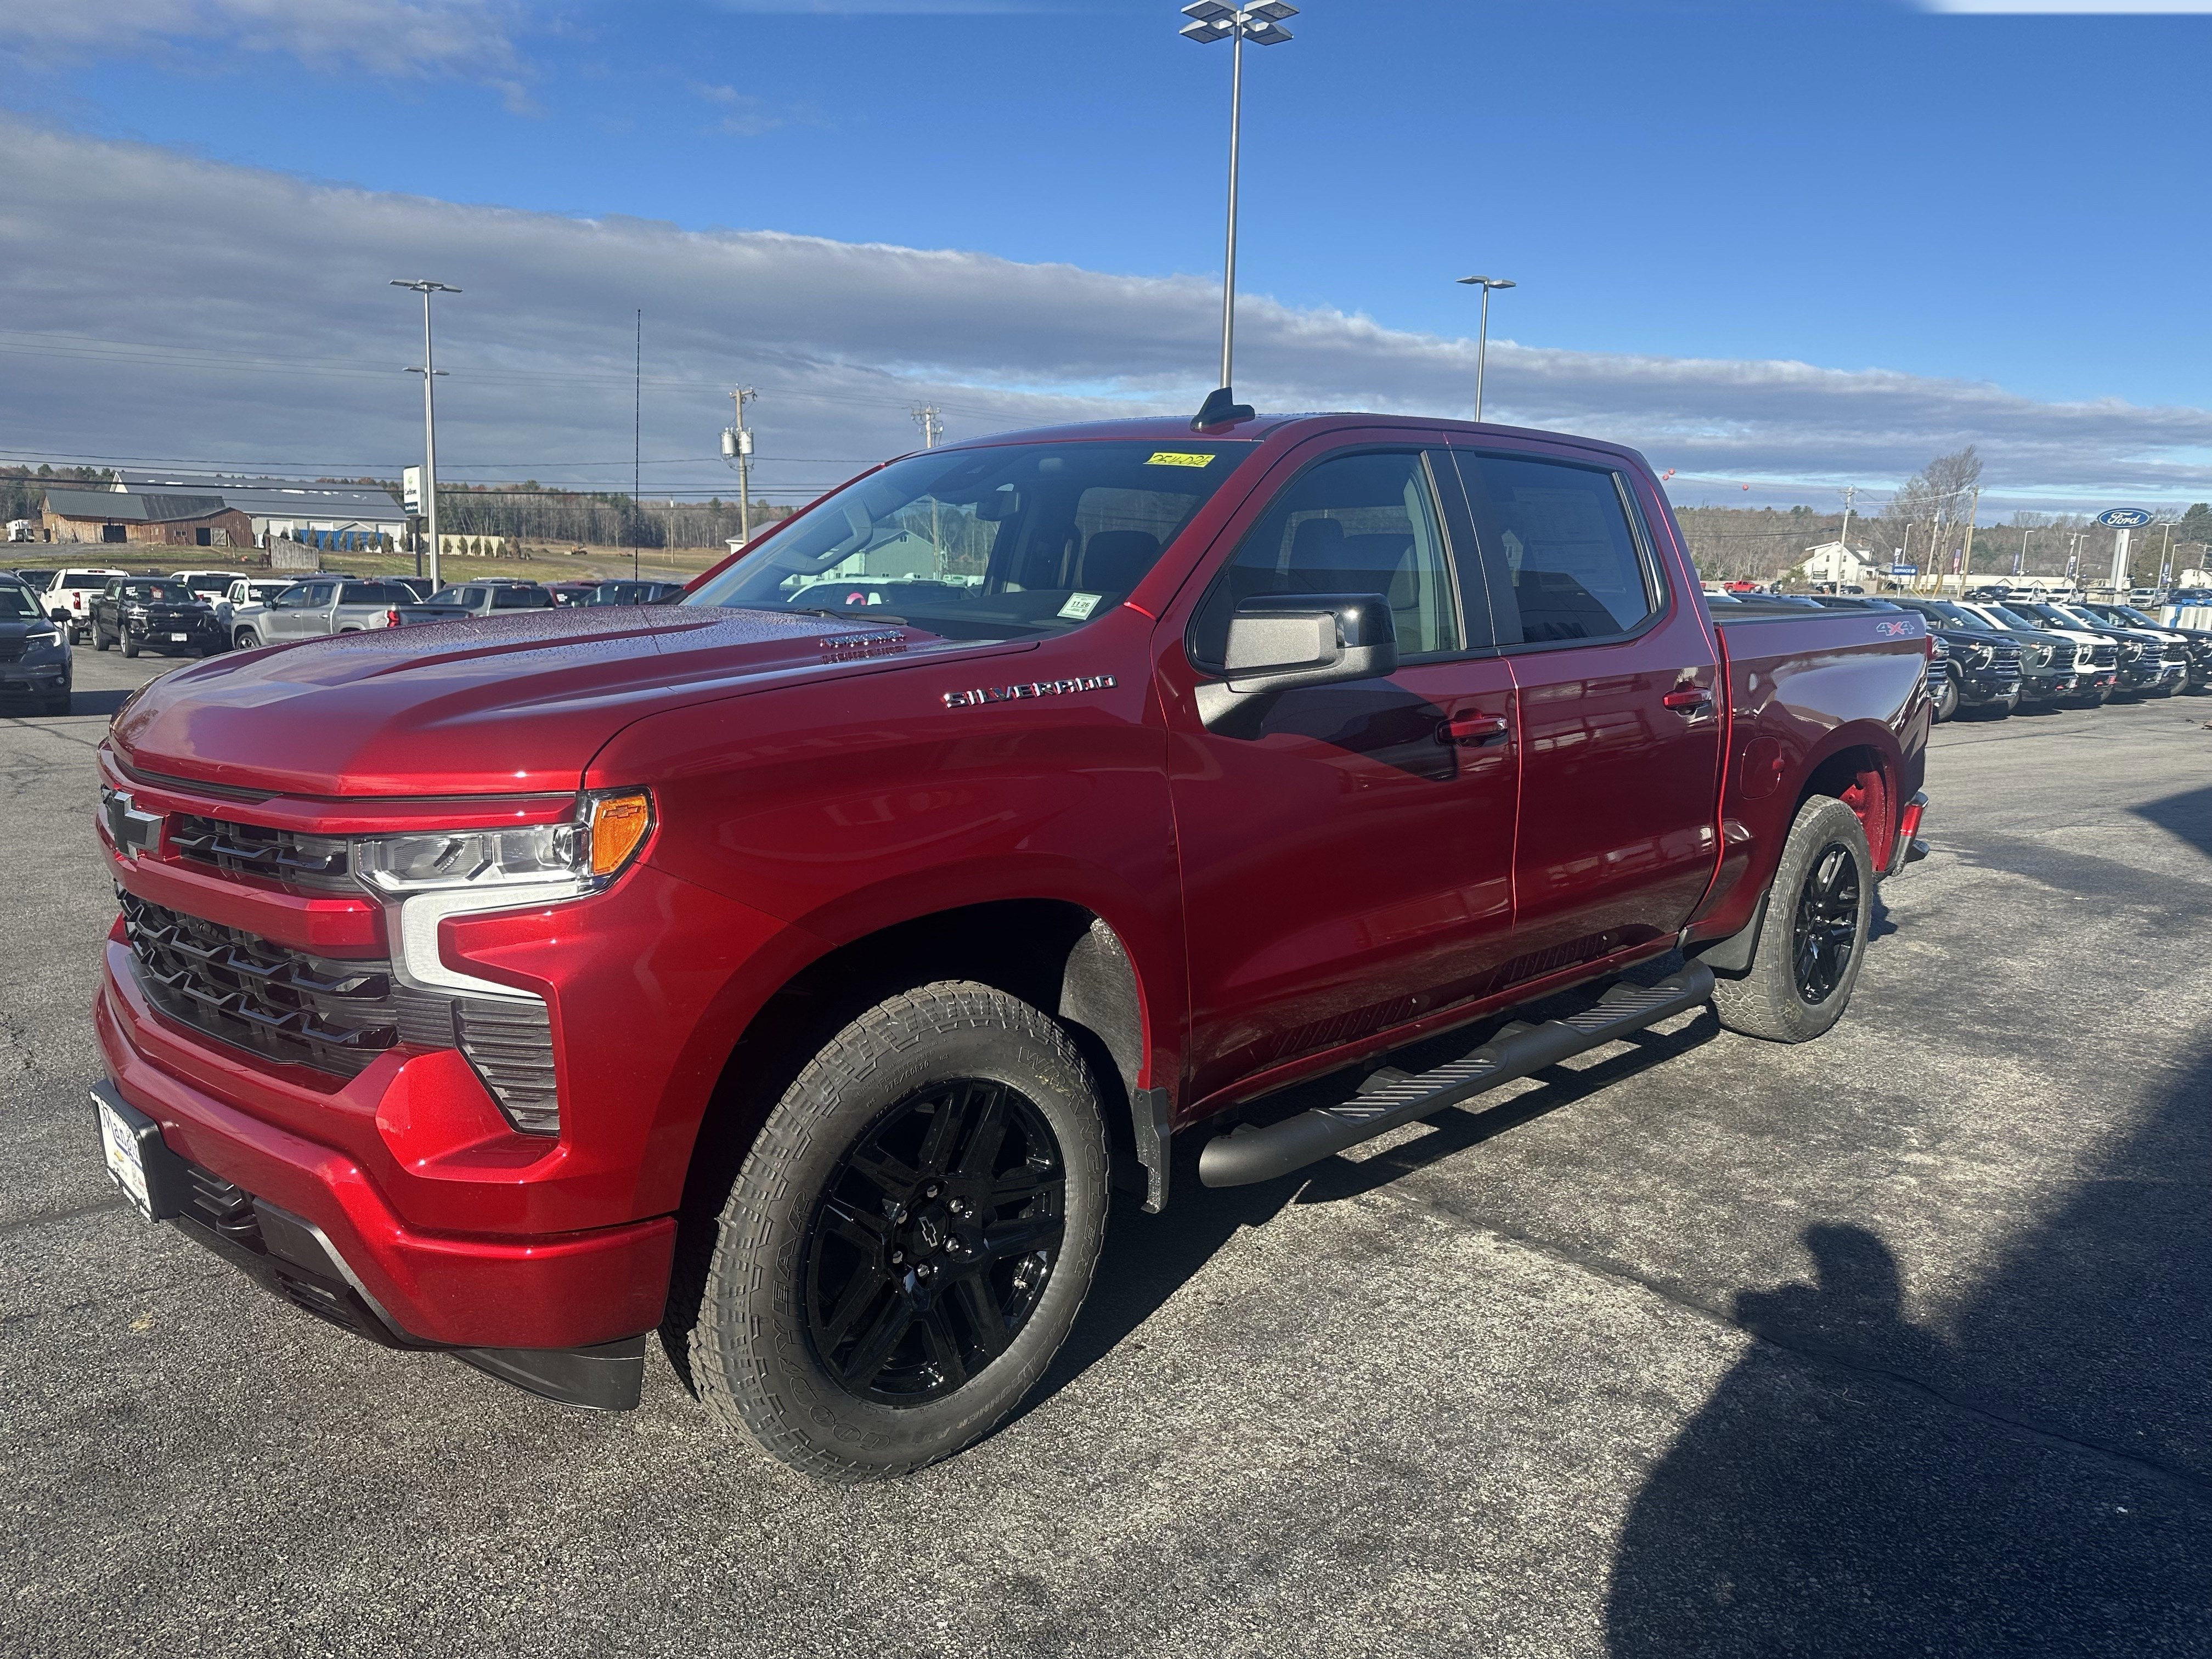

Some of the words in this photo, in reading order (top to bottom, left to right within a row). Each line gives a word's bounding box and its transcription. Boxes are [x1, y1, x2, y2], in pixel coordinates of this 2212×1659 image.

[2107, 512, 2141, 524] Ford
[943, 674, 1118, 708] SILVERADO
[885, 1060, 930, 1093] 275/60R20
[1018, 1046, 1101, 1278] WRANGLER
[772, 1191, 890, 1450] GOODYEAR
